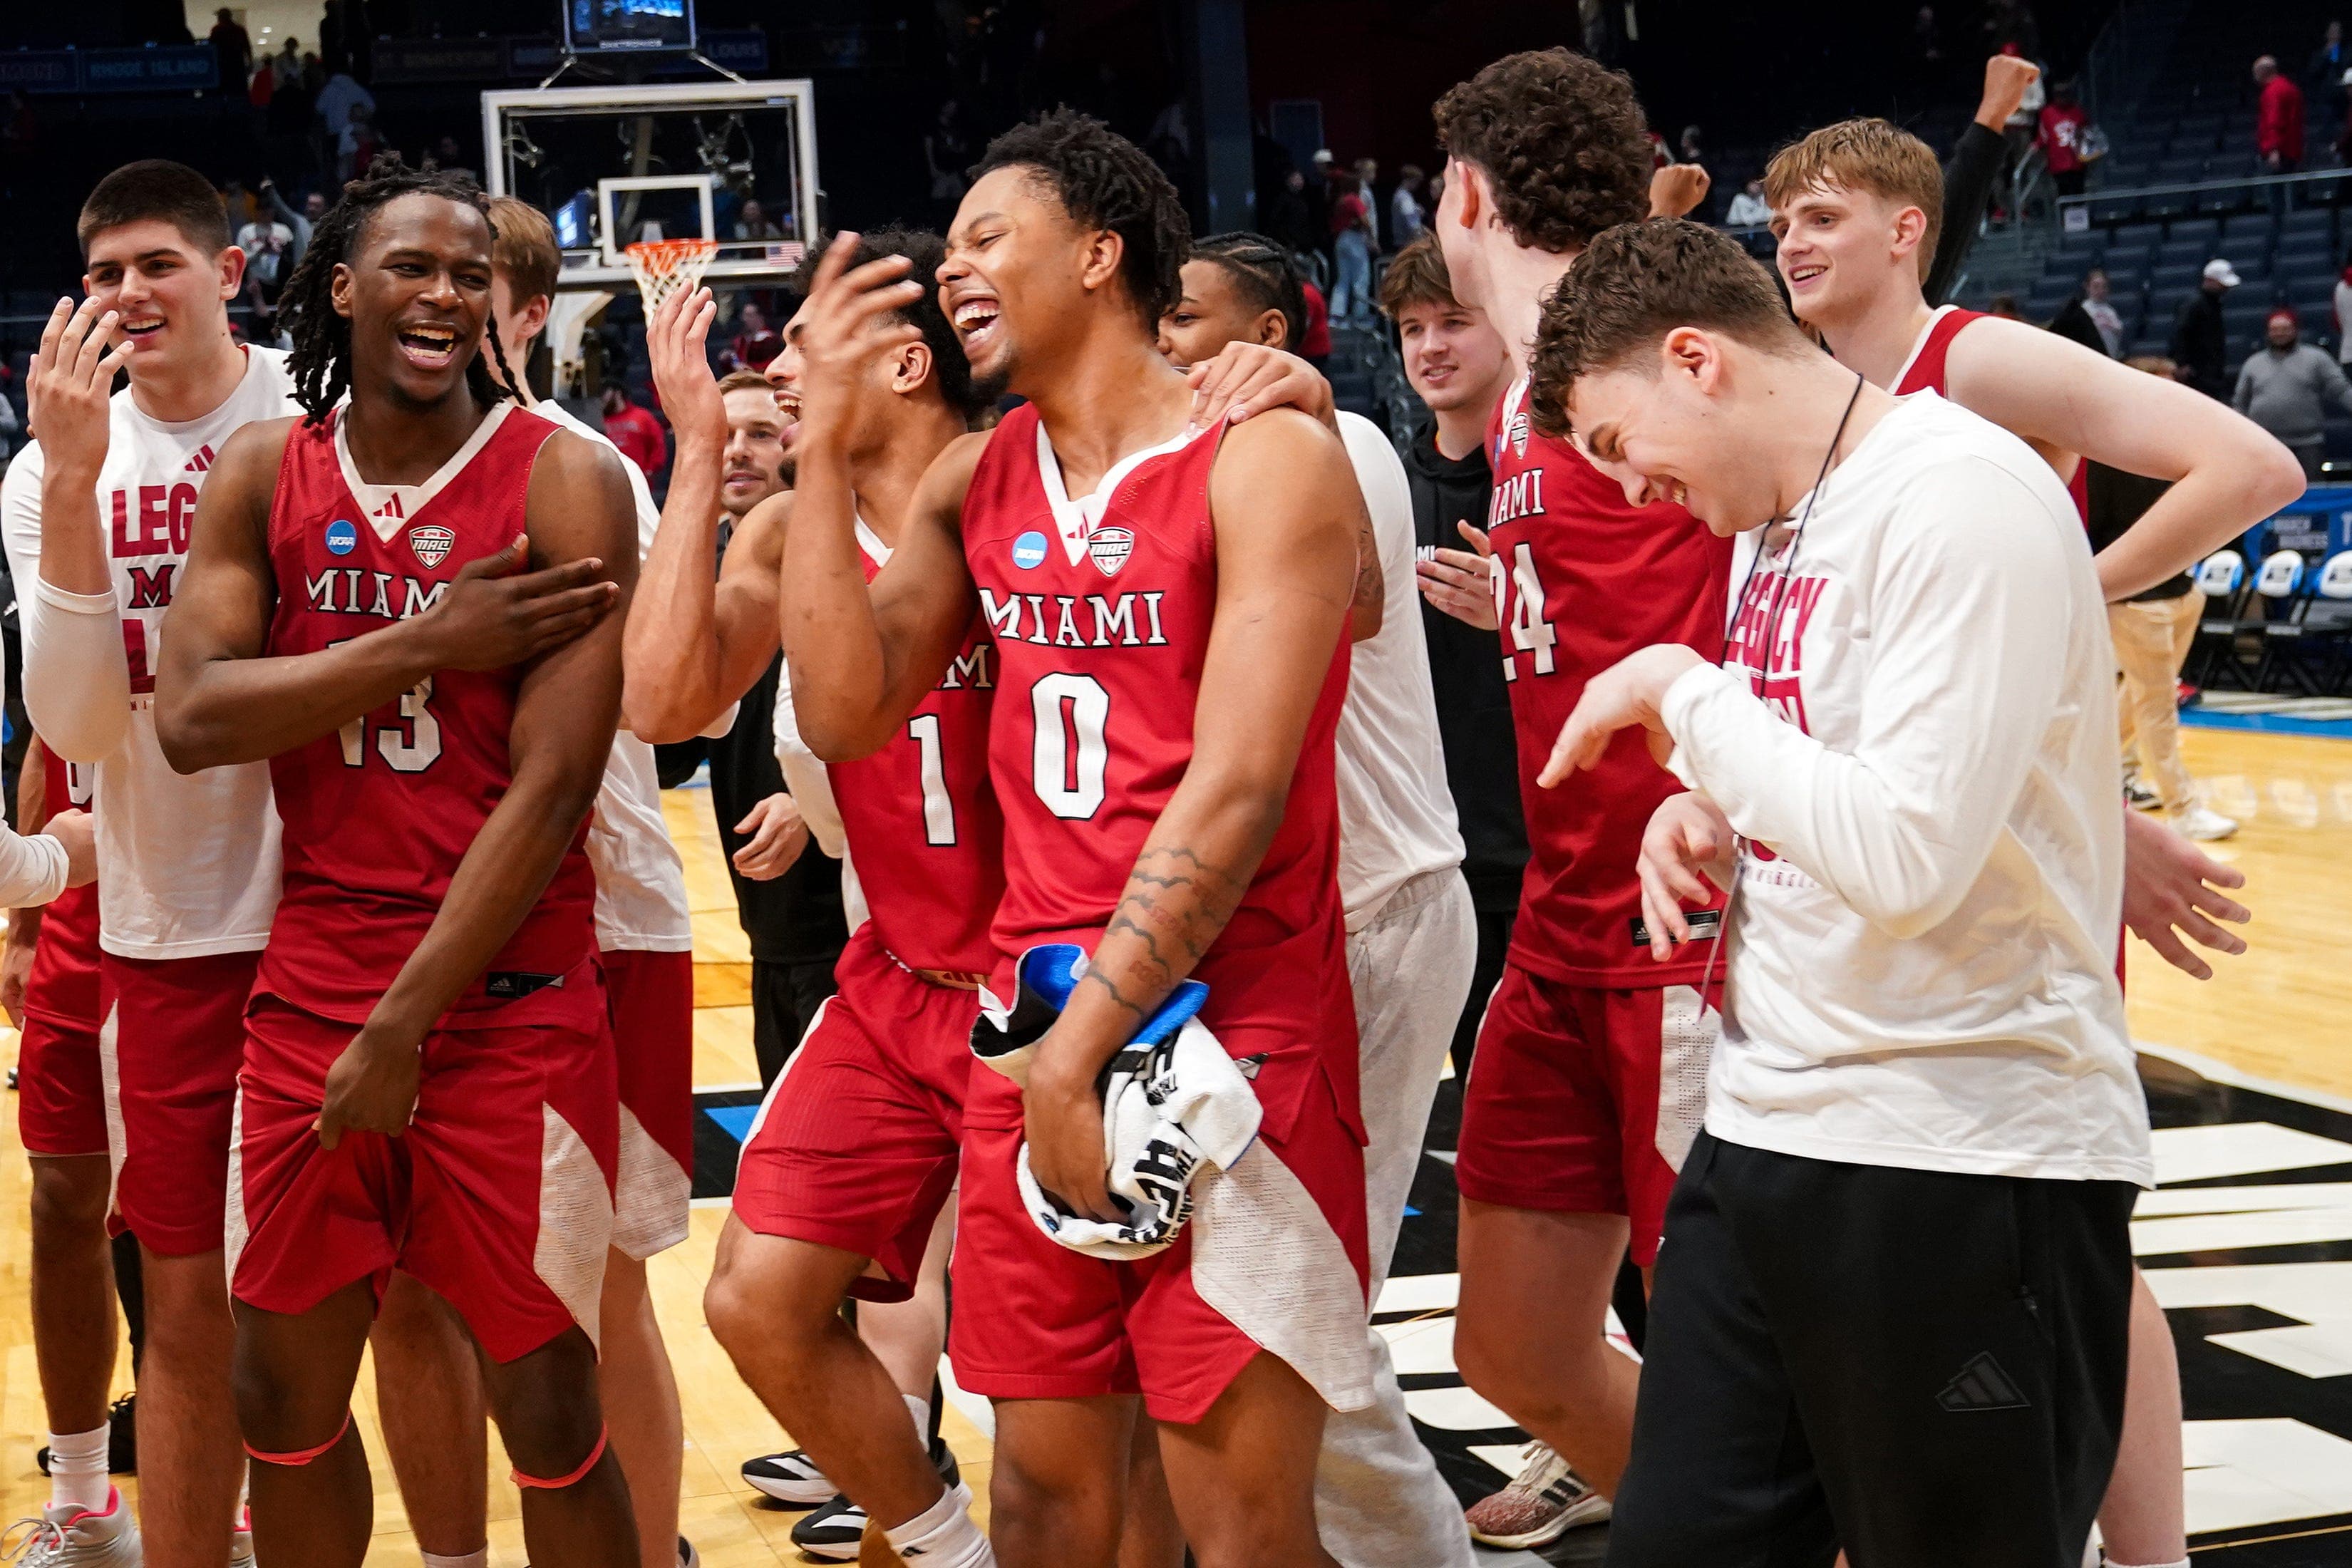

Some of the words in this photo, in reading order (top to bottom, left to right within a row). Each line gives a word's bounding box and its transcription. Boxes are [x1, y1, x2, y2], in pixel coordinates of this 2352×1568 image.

[111, 482, 197, 558] LEG
[1488, 468, 1545, 530] IAMI
[413, 539, 450, 551] MAC
[1091, 543, 1130, 556] MAC
[127, 564, 176, 609] M
[305, 567, 451, 620] MIAM
[979, 587, 1170, 648] MIAMI
[1031, 671, 1109, 821] 0
[908, 713, 957, 847] 1
